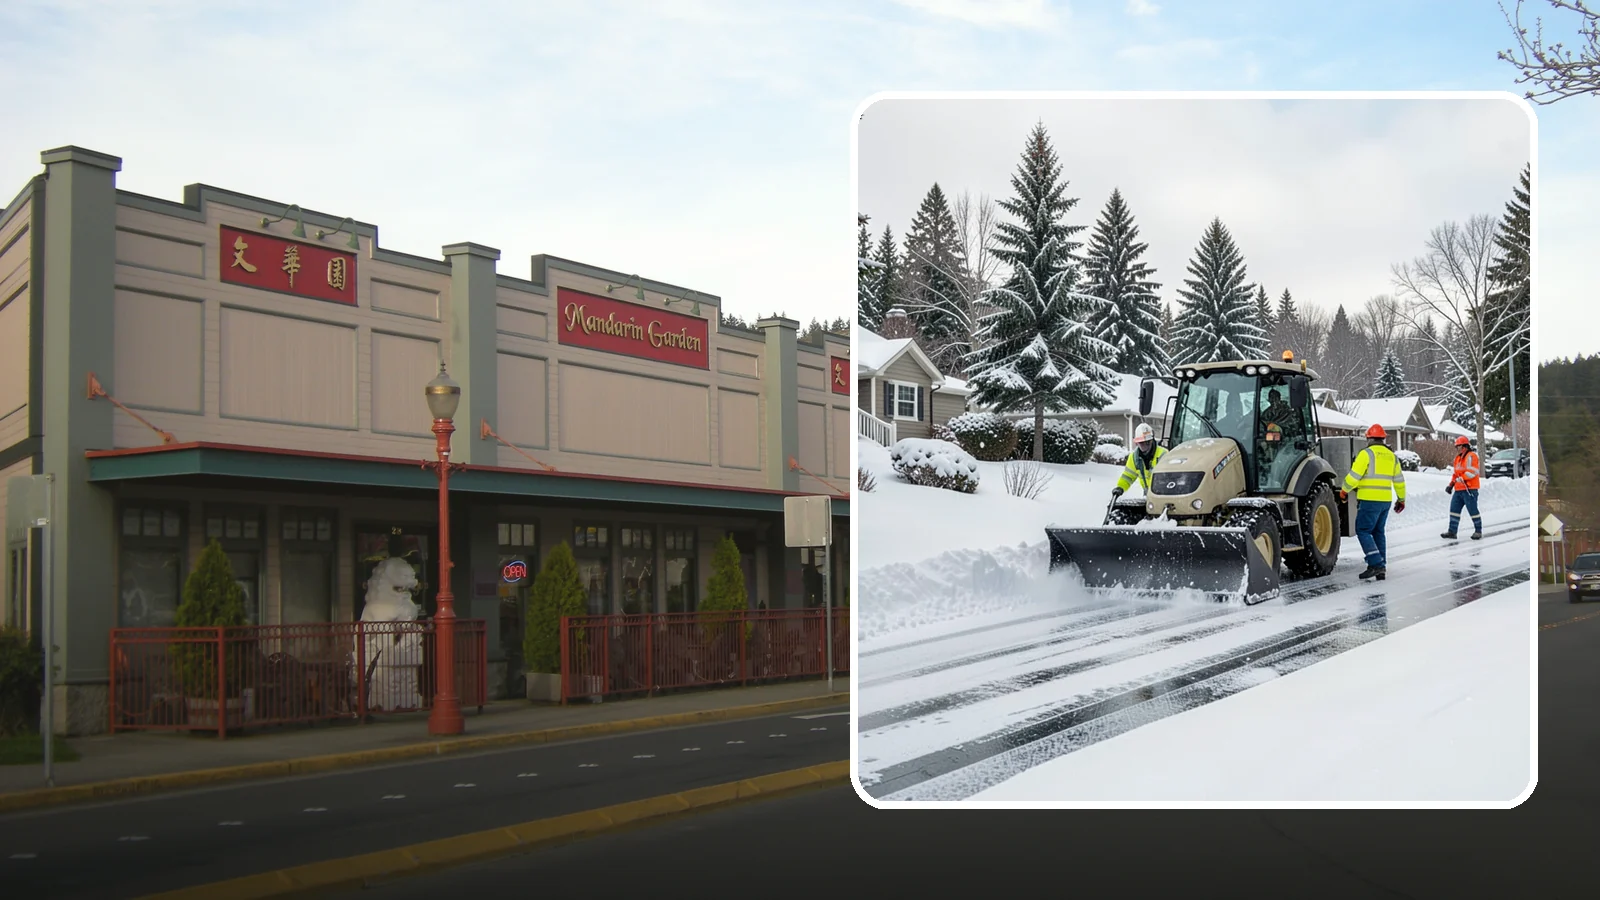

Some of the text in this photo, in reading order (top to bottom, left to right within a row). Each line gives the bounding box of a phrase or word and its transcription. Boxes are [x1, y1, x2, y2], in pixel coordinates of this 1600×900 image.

[564, 302, 701, 352] Mandarin Garden
[835, 363, 846, 386] 文
[503, 565, 527, 578] OPEN
